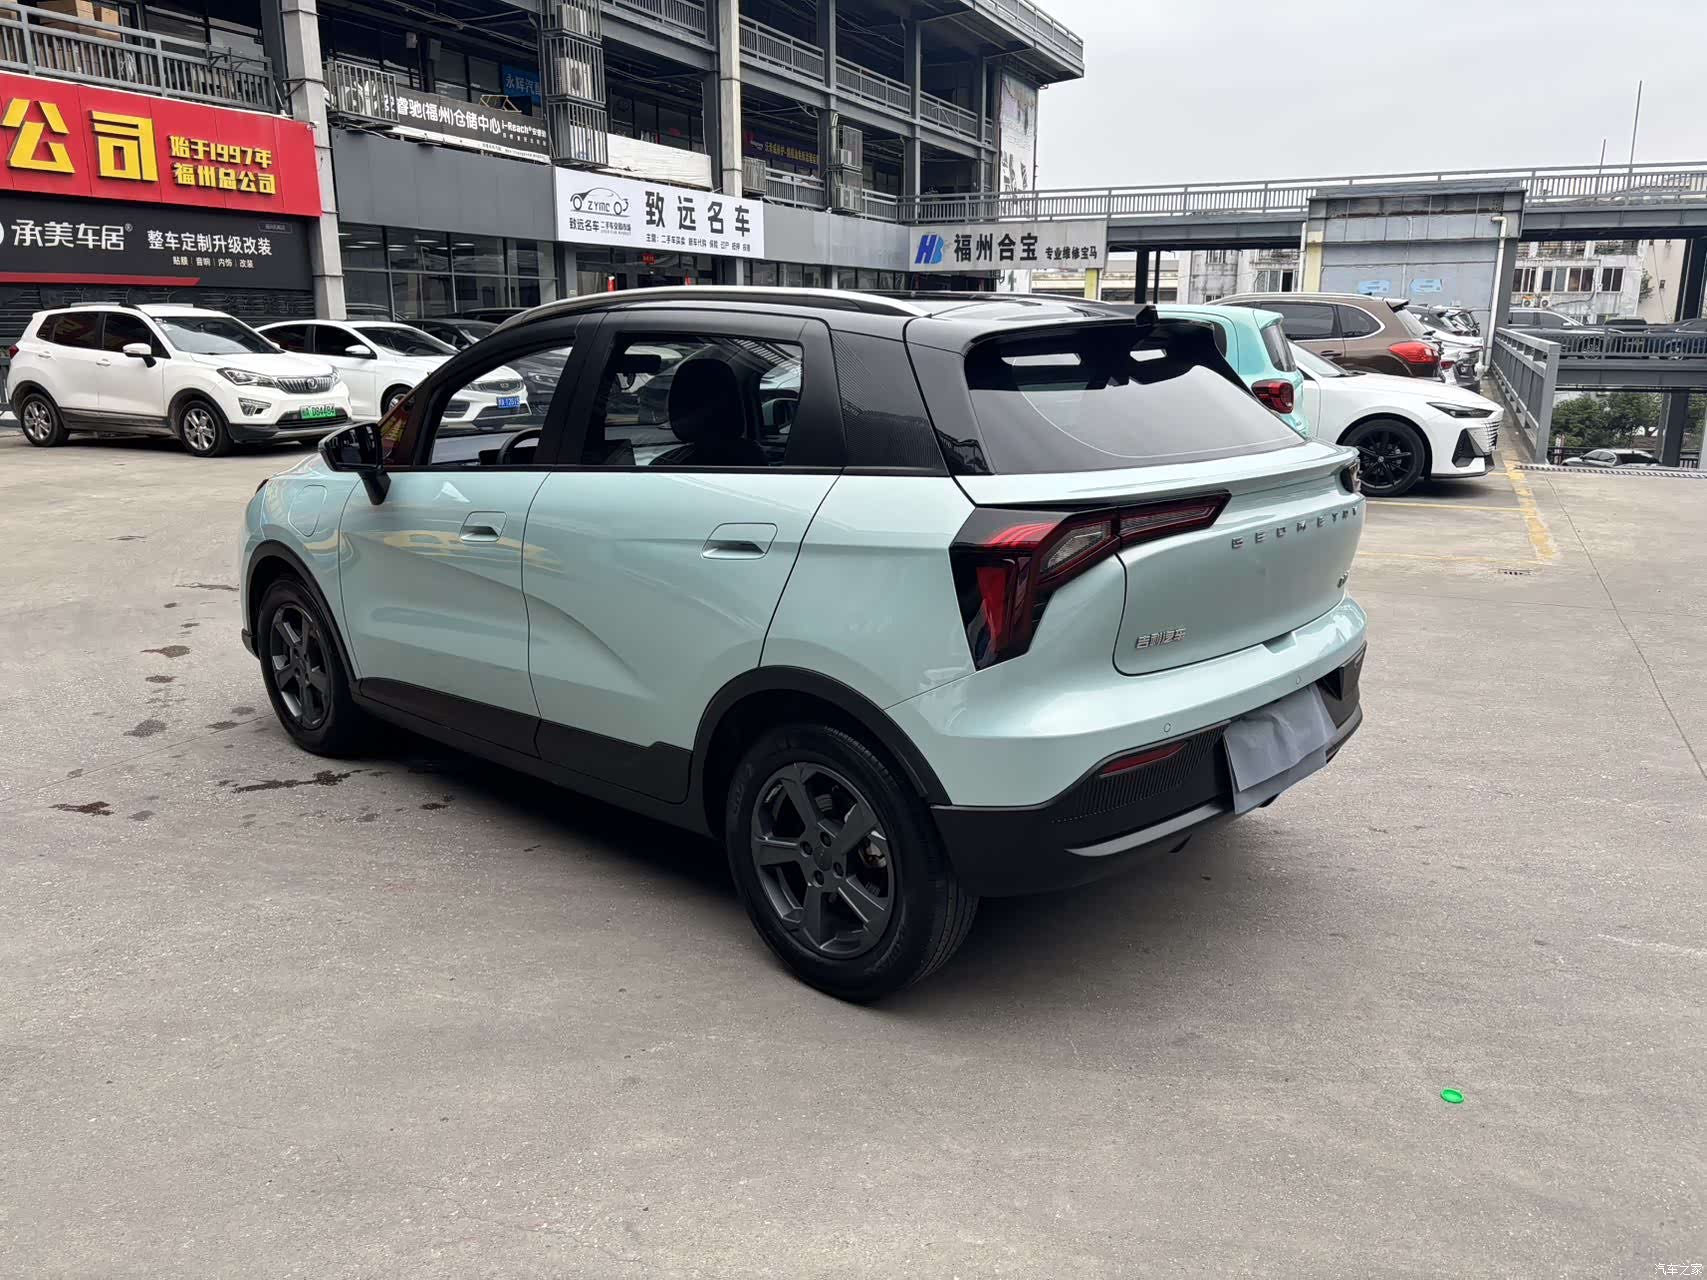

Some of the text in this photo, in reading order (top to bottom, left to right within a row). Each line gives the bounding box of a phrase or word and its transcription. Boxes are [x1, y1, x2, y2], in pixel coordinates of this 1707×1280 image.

[1, 98, 159, 183] 公司
[169, 135, 273, 169] 始于1997年
[174, 162, 277, 195] 福州总公司
[569, 217, 599, 232] 致远名车
[645, 190, 751, 237] 致远名车
[147, 230, 273, 257] 整车定制升级改装
[954, 232, 1038, 263] 福州合宝
[1045, 245, 1098, 261] 专业维修宝马
[173, 255, 254, 269] 贴膜 音响 内饰 改装
[1135, 627, 1186, 649] 吉利汽车
